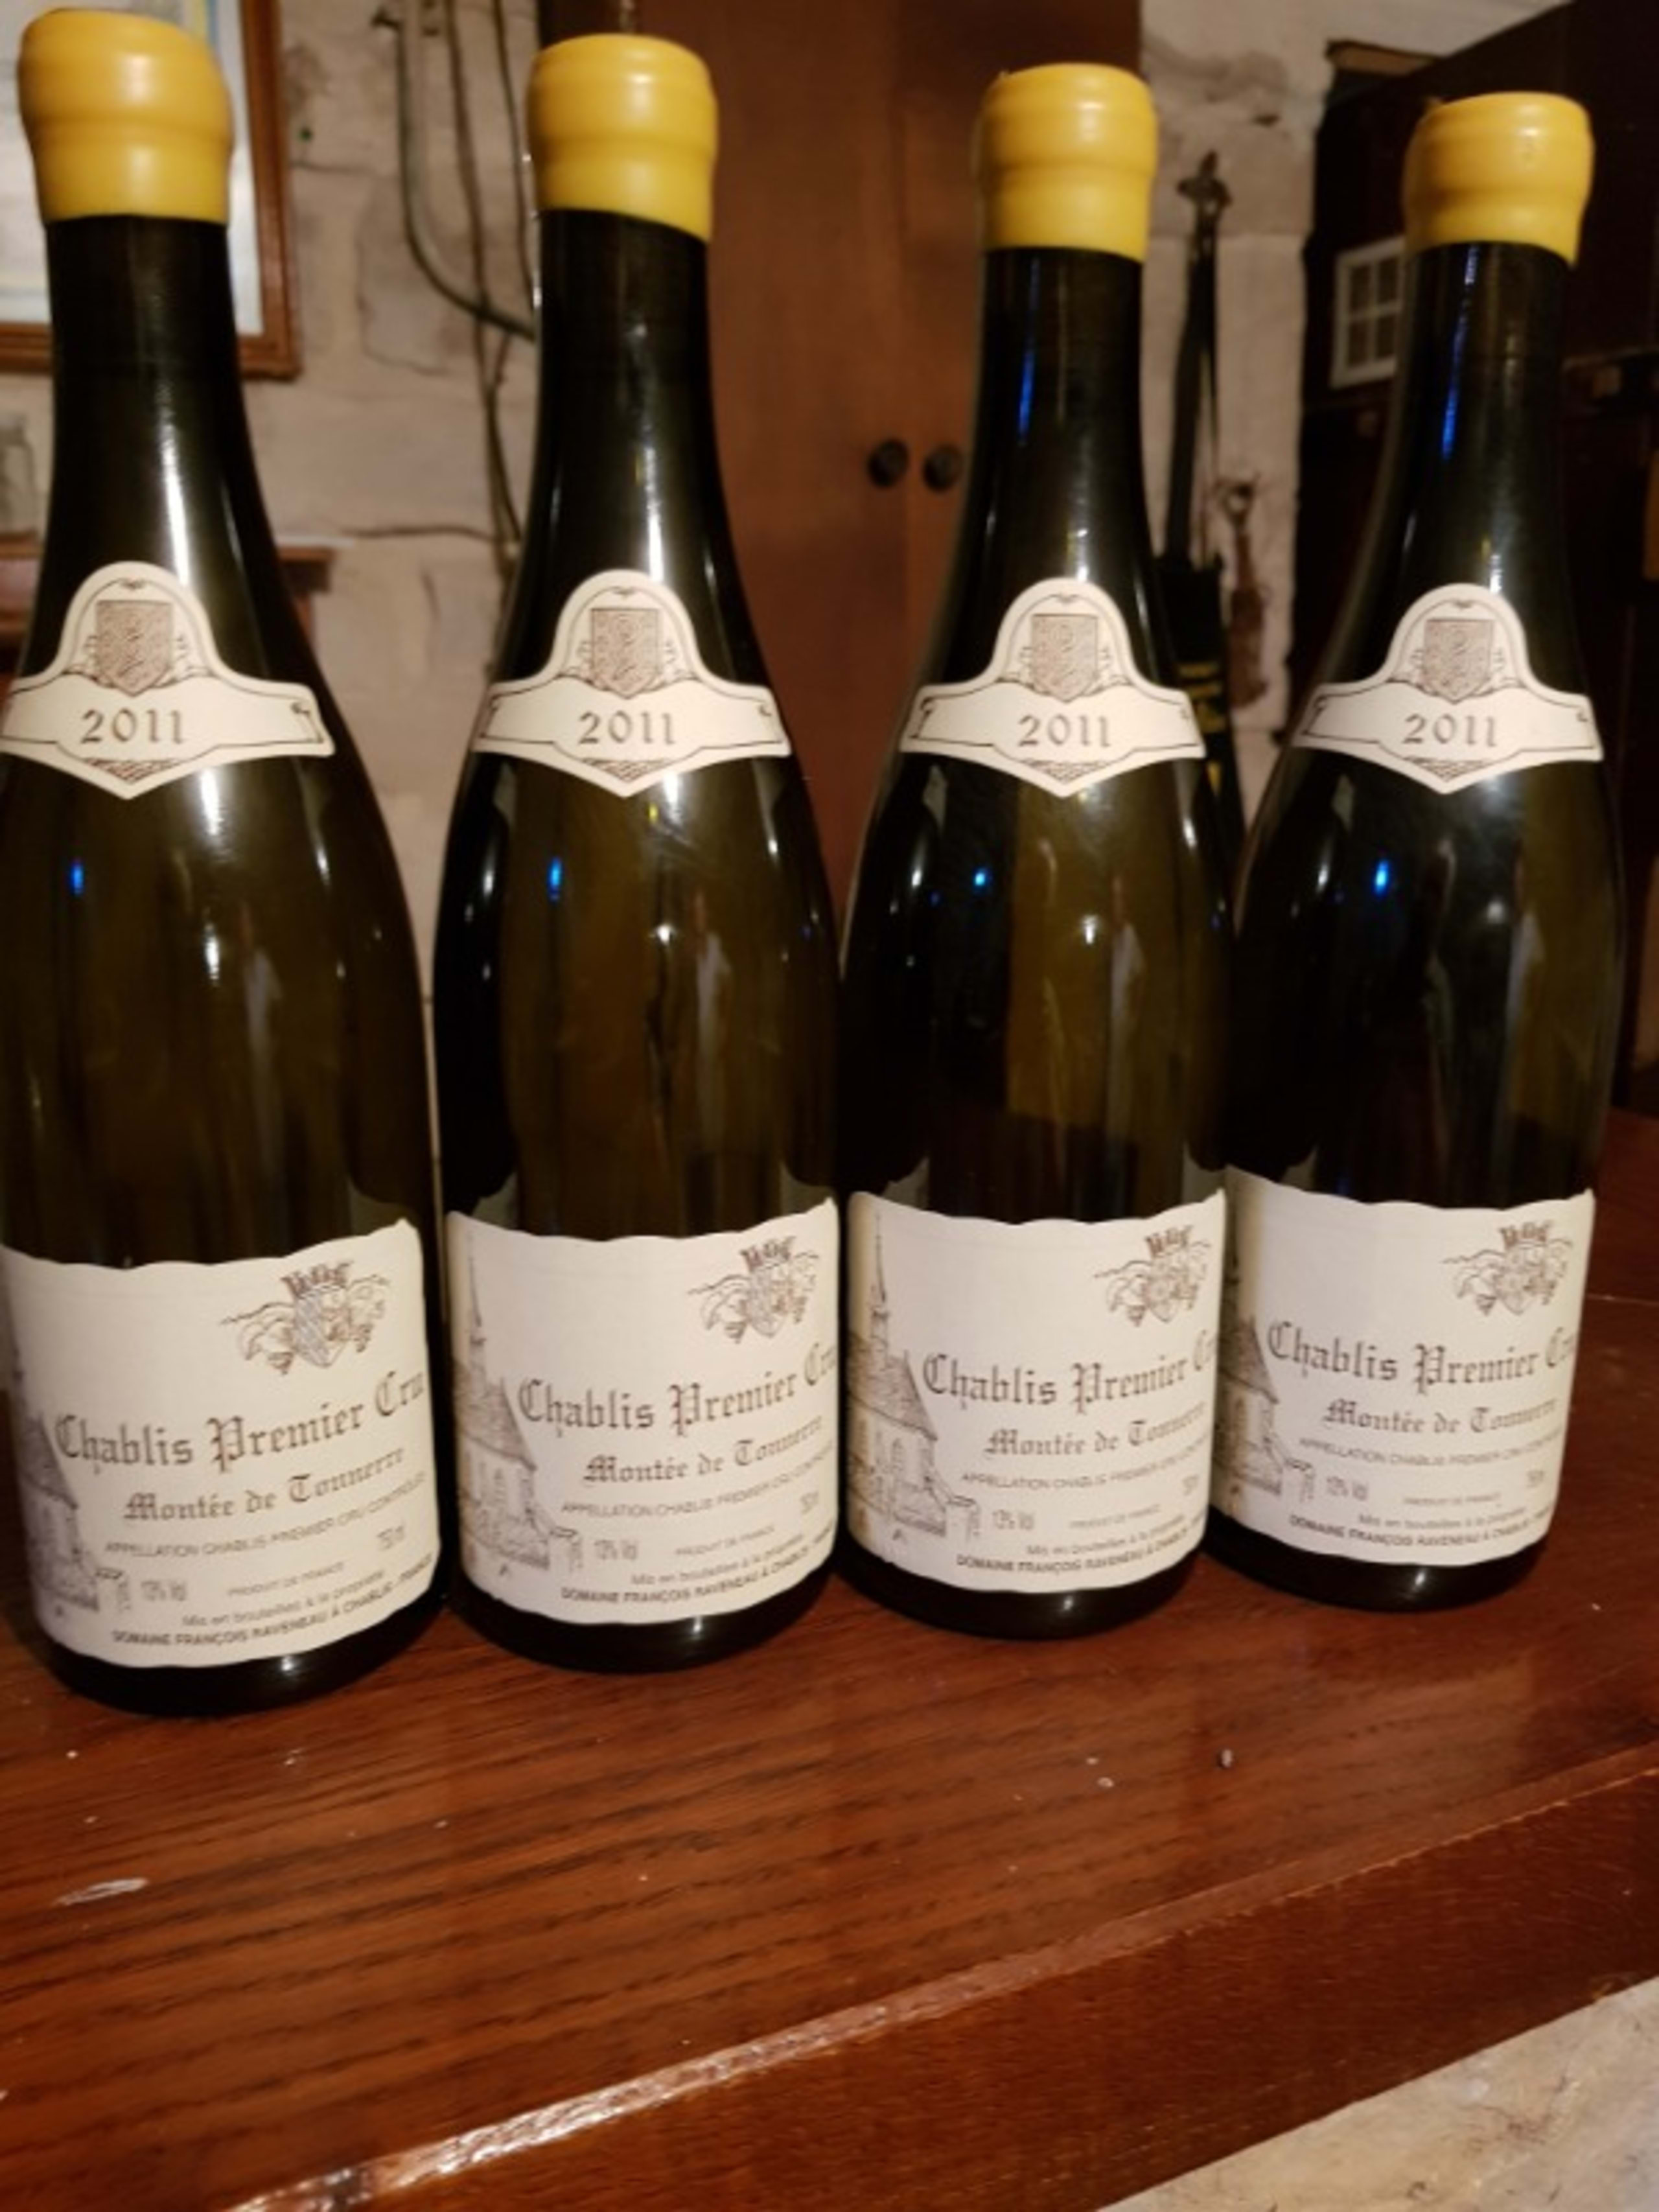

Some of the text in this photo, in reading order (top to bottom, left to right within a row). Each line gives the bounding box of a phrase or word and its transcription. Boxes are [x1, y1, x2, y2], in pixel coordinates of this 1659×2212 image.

[80, 708, 185, 745] 2011
[578, 709, 675, 746] 2011
[1017, 714, 1110, 749] 2011
[1404, 714, 1497, 749] 2011
[1268, 1321, 1397, 1379] Chablis
[1415, 1344, 1539, 1395] Premier
[923, 1353, 1056, 1410] Chablis
[1071, 1355, 1187, 1415] Premier
[518, 1378, 655, 1438] Chablis
[667, 1371, 797, 1437] Premier
[55, 1414, 193, 1474] Chablis
[206, 1403, 364, 1473] Premier
[1434, 1412, 1459, 1433] de
[984, 1428, 1085, 1456] Montée
[1095, 1430, 1119, 1452] de
[584, 1455, 688, 1482] Montée
[699, 1453, 724, 1475] de
[124, 1493, 235, 1519] Montée
[246, 1490, 276, 1513] de
[111, 1630, 170, 1645] DOMAINE
[175, 1629, 248, 1646] FRANÇOIS
